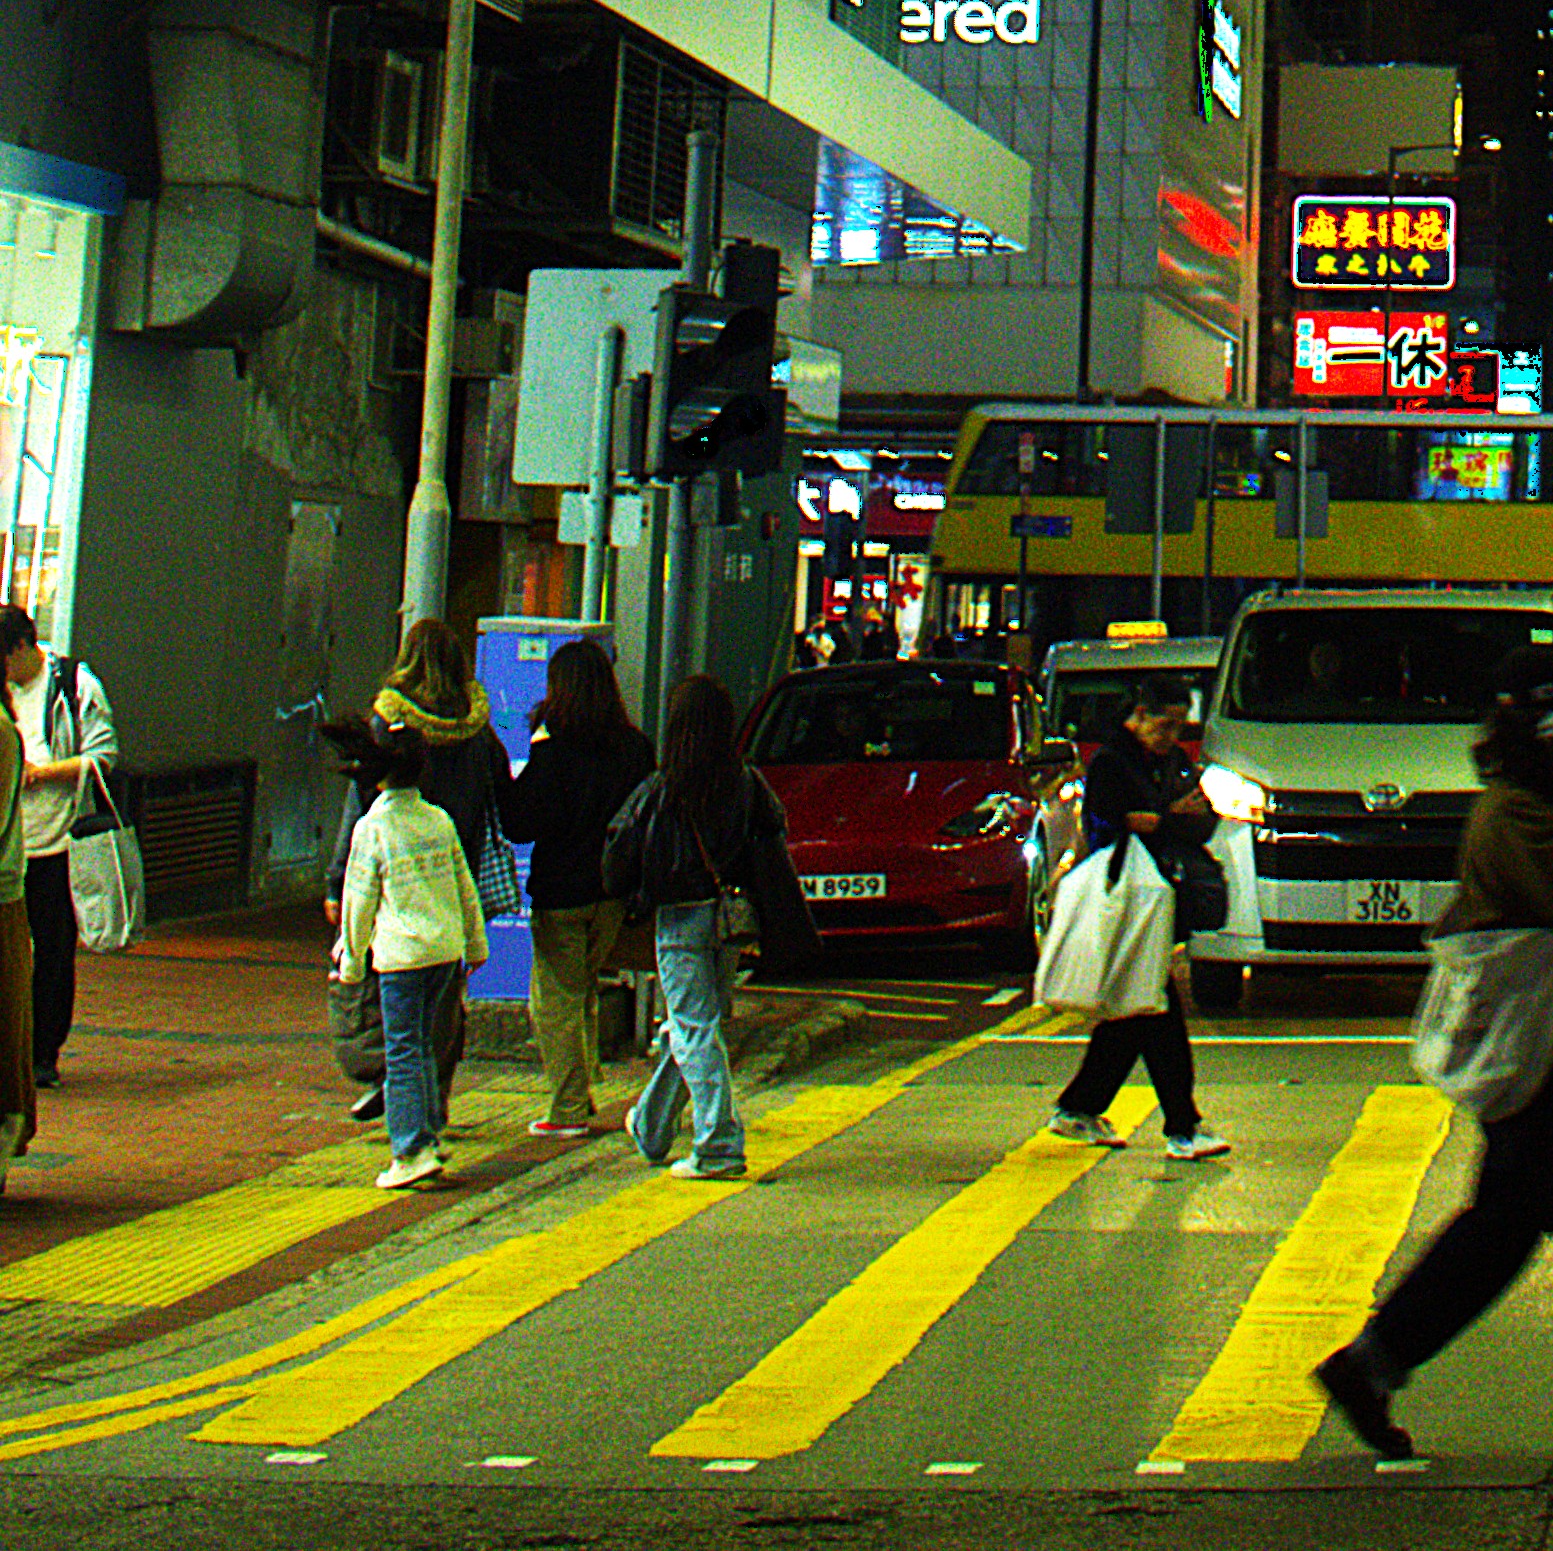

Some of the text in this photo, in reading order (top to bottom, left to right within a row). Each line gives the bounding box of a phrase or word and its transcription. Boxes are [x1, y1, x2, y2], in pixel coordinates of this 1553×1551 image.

[823, 877, 883, 897] 8959
[1369, 881, 1401, 902] XN
[1356, 901, 1412, 921] 3156
